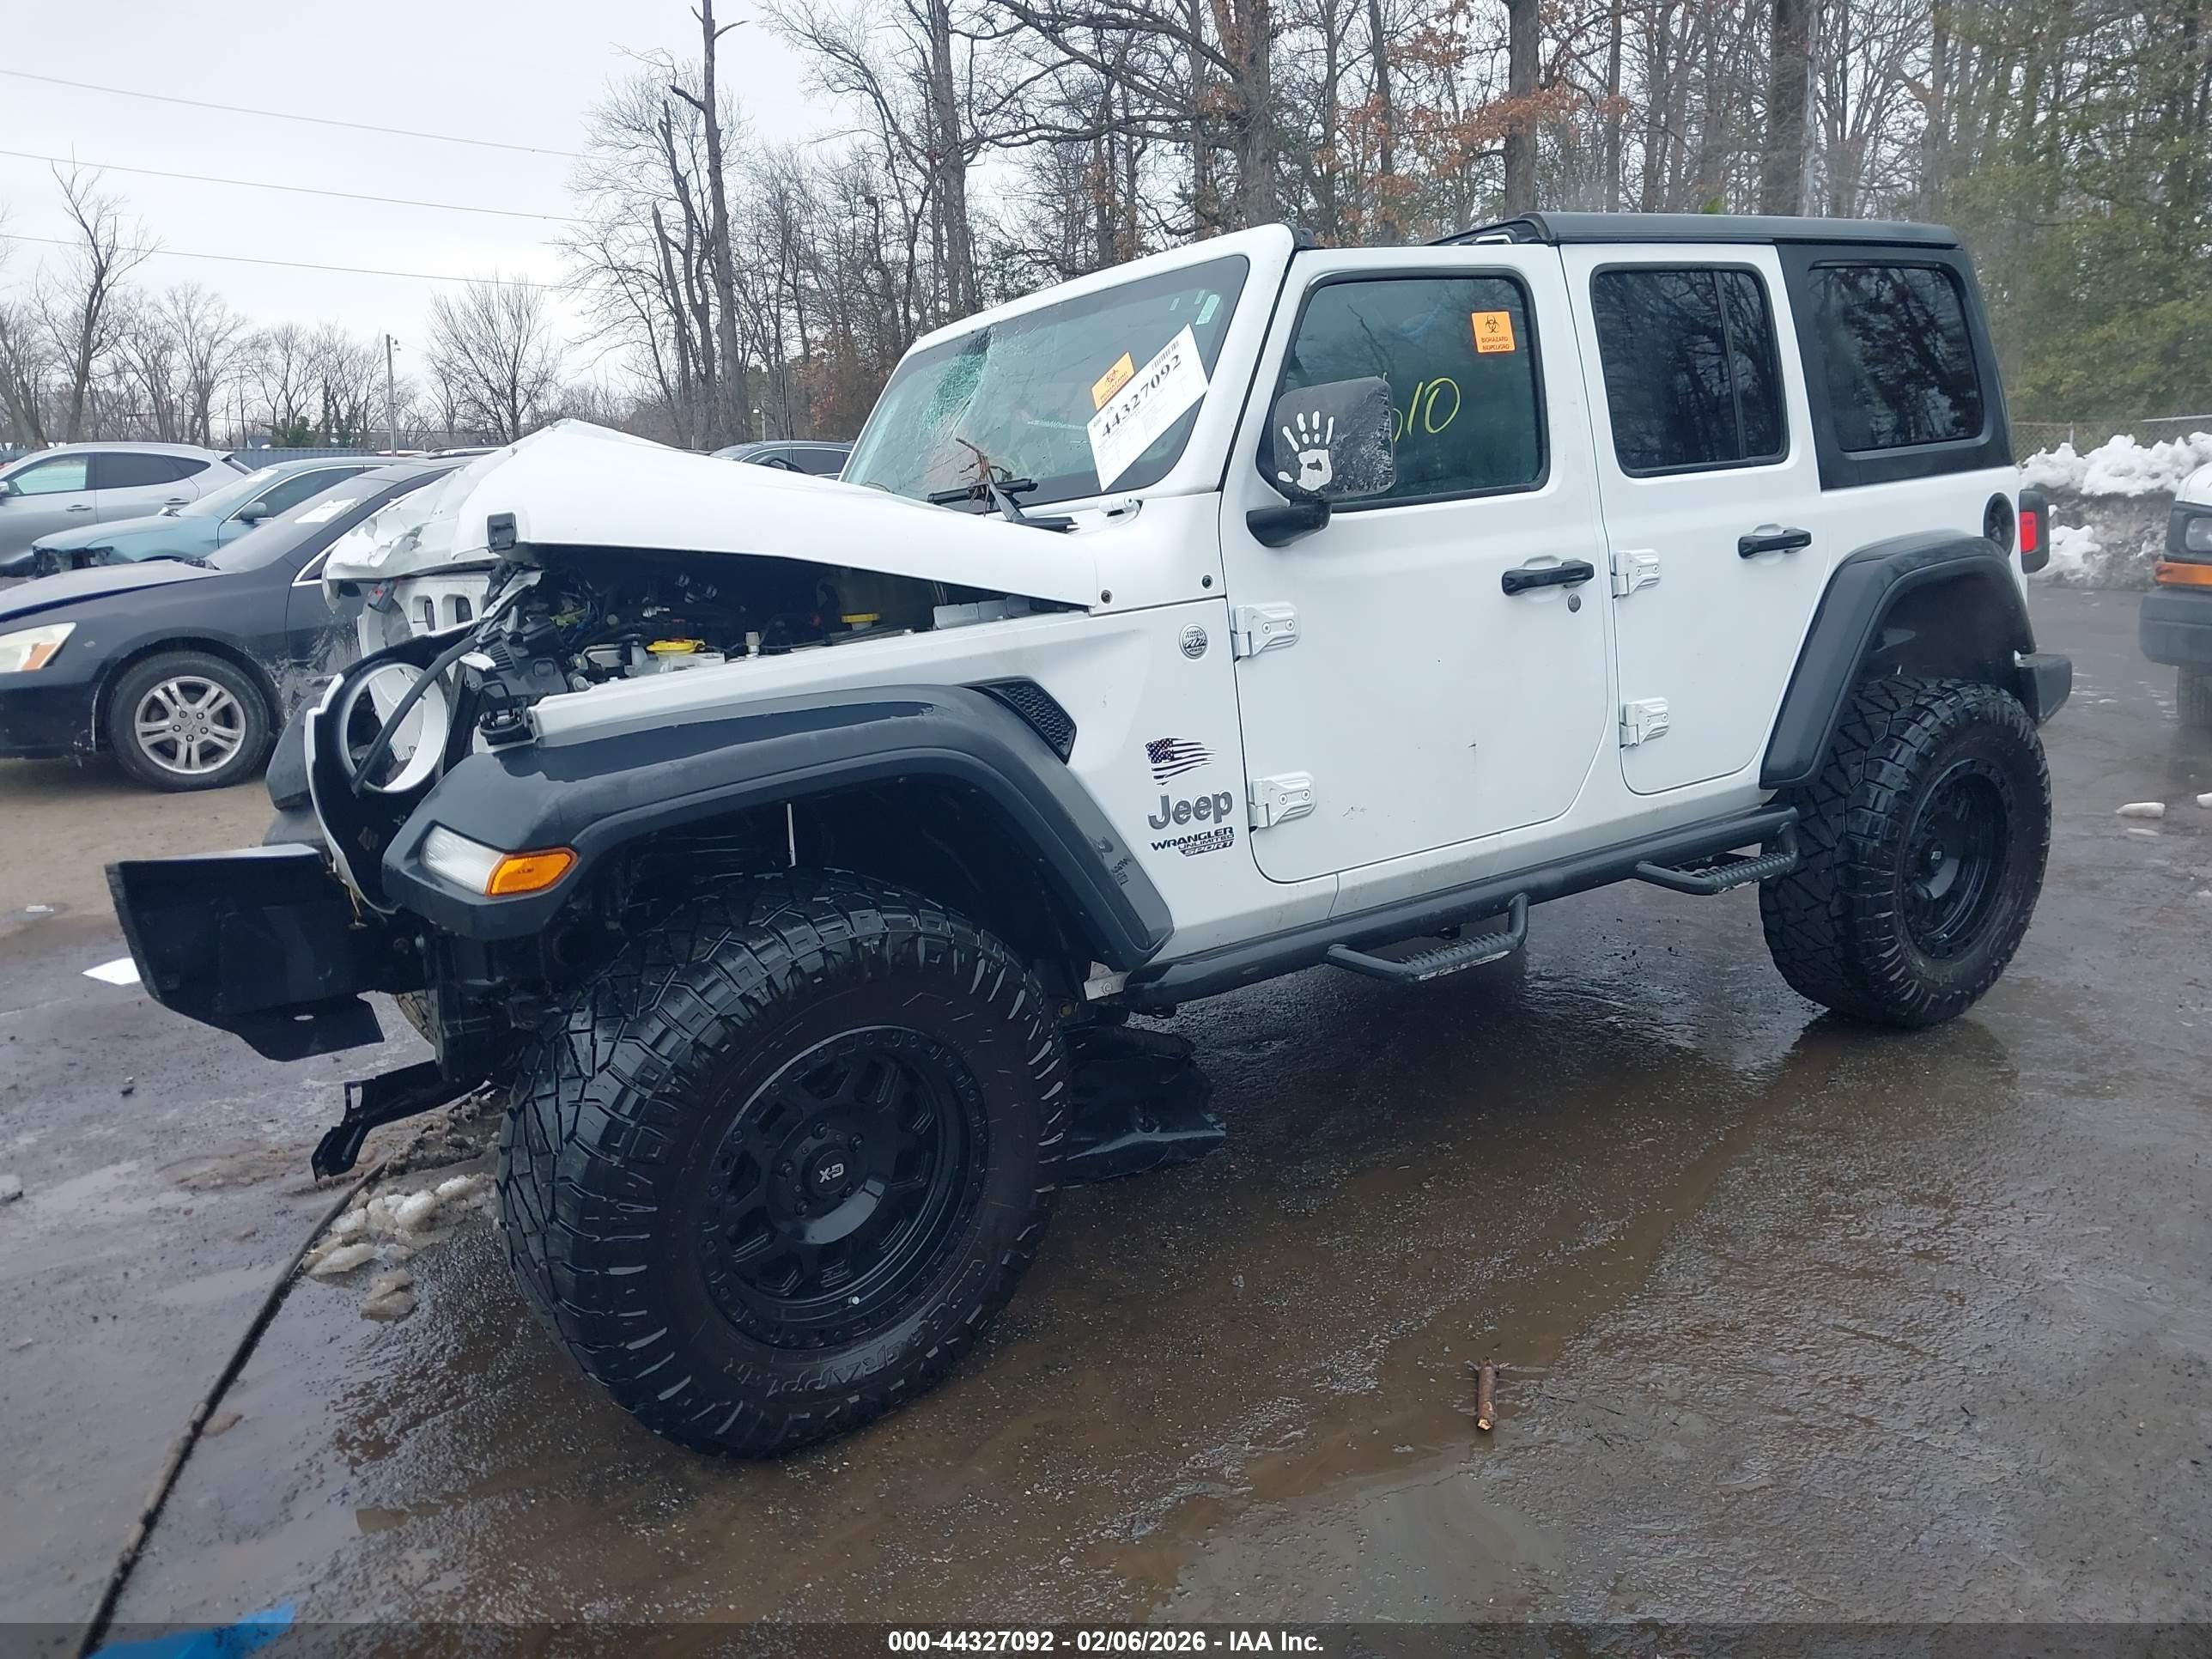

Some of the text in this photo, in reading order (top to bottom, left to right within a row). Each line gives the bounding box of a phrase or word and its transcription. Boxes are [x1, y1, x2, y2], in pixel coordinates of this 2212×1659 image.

[1102, 354, 1182, 439] 44327092
[1148, 791, 1233, 830] Jeep
[1151, 826, 1234, 851] WRANGLER
[1178, 834, 1235, 850] UNLIMITED
[1183, 841, 1233, 855] SPORT
